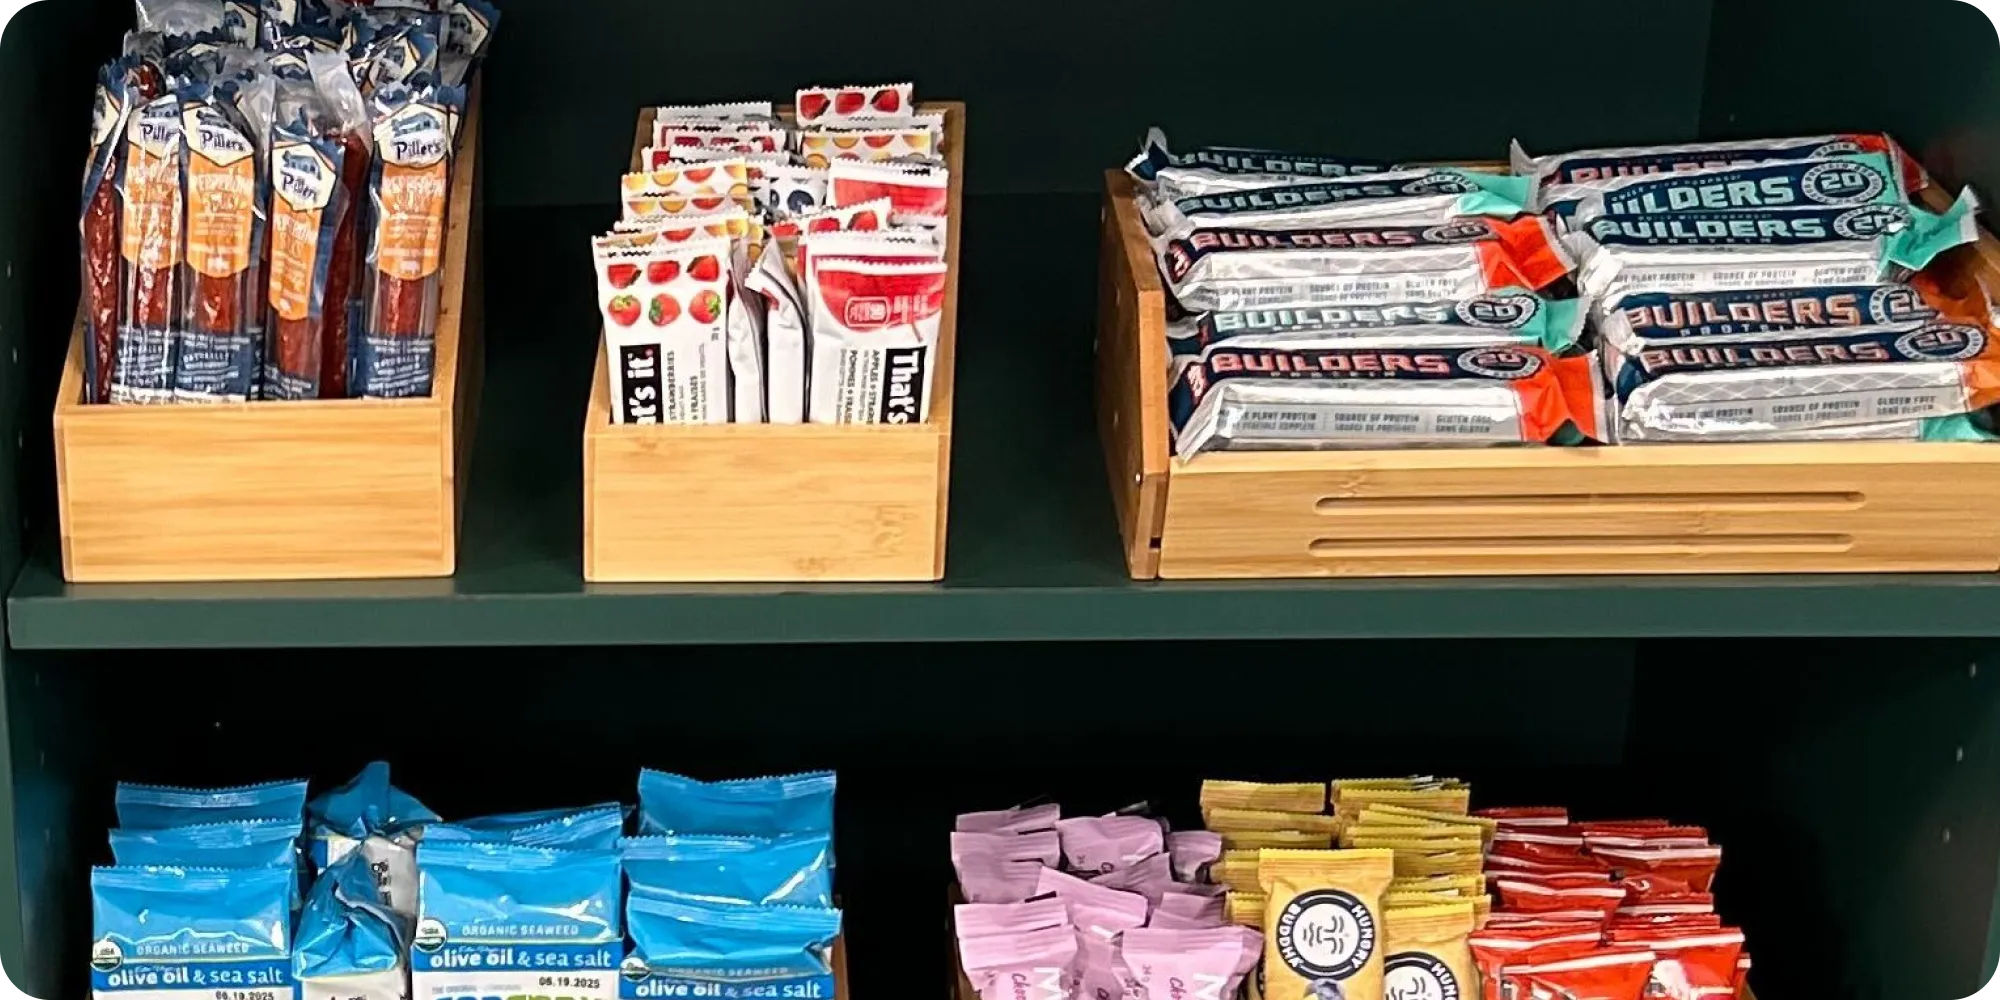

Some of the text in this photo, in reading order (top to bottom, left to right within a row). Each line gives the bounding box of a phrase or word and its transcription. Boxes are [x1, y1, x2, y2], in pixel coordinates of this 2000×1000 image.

[1821, 172, 1864, 190] 20
[1592, 217, 1826, 240] BUILDERS
[1190, 229, 1416, 251] BUILDERS
[1214, 304, 1448, 333] BUILDERS
[1625, 294, 1860, 328] BUILDERS
[1640, 342, 1890, 373] BUILDERS
[1919, 331, 1962, 347] 20
[1211, 353, 1450, 374] BUILDERS
[887, 350, 920, 424] That's
[462, 924, 579, 936] ORGANIC SEAWEED
[1277, 903, 1303, 968] BUDDHA
[1351, 904, 1374, 968] HUNGRY
[137, 943, 250, 956] ORGANIC SEAWEED
[430, 950, 481, 968] olive
[486, 947, 514, 967] oil
[517, 951, 533, 968] &
[535, 952, 569, 967] sea
[574, 951, 611, 968] salt
[108, 971, 158, 987] olive
[162, 966, 190, 984] oil
[193, 971, 207, 985] &
[210, 970, 243, 983] sea
[247, 967, 283, 984] salt
[635, 979, 688, 997] olive
[693, 981, 721, 996] oil
[743, 986, 778, 998] sea
[783, 980, 821, 998] salt
